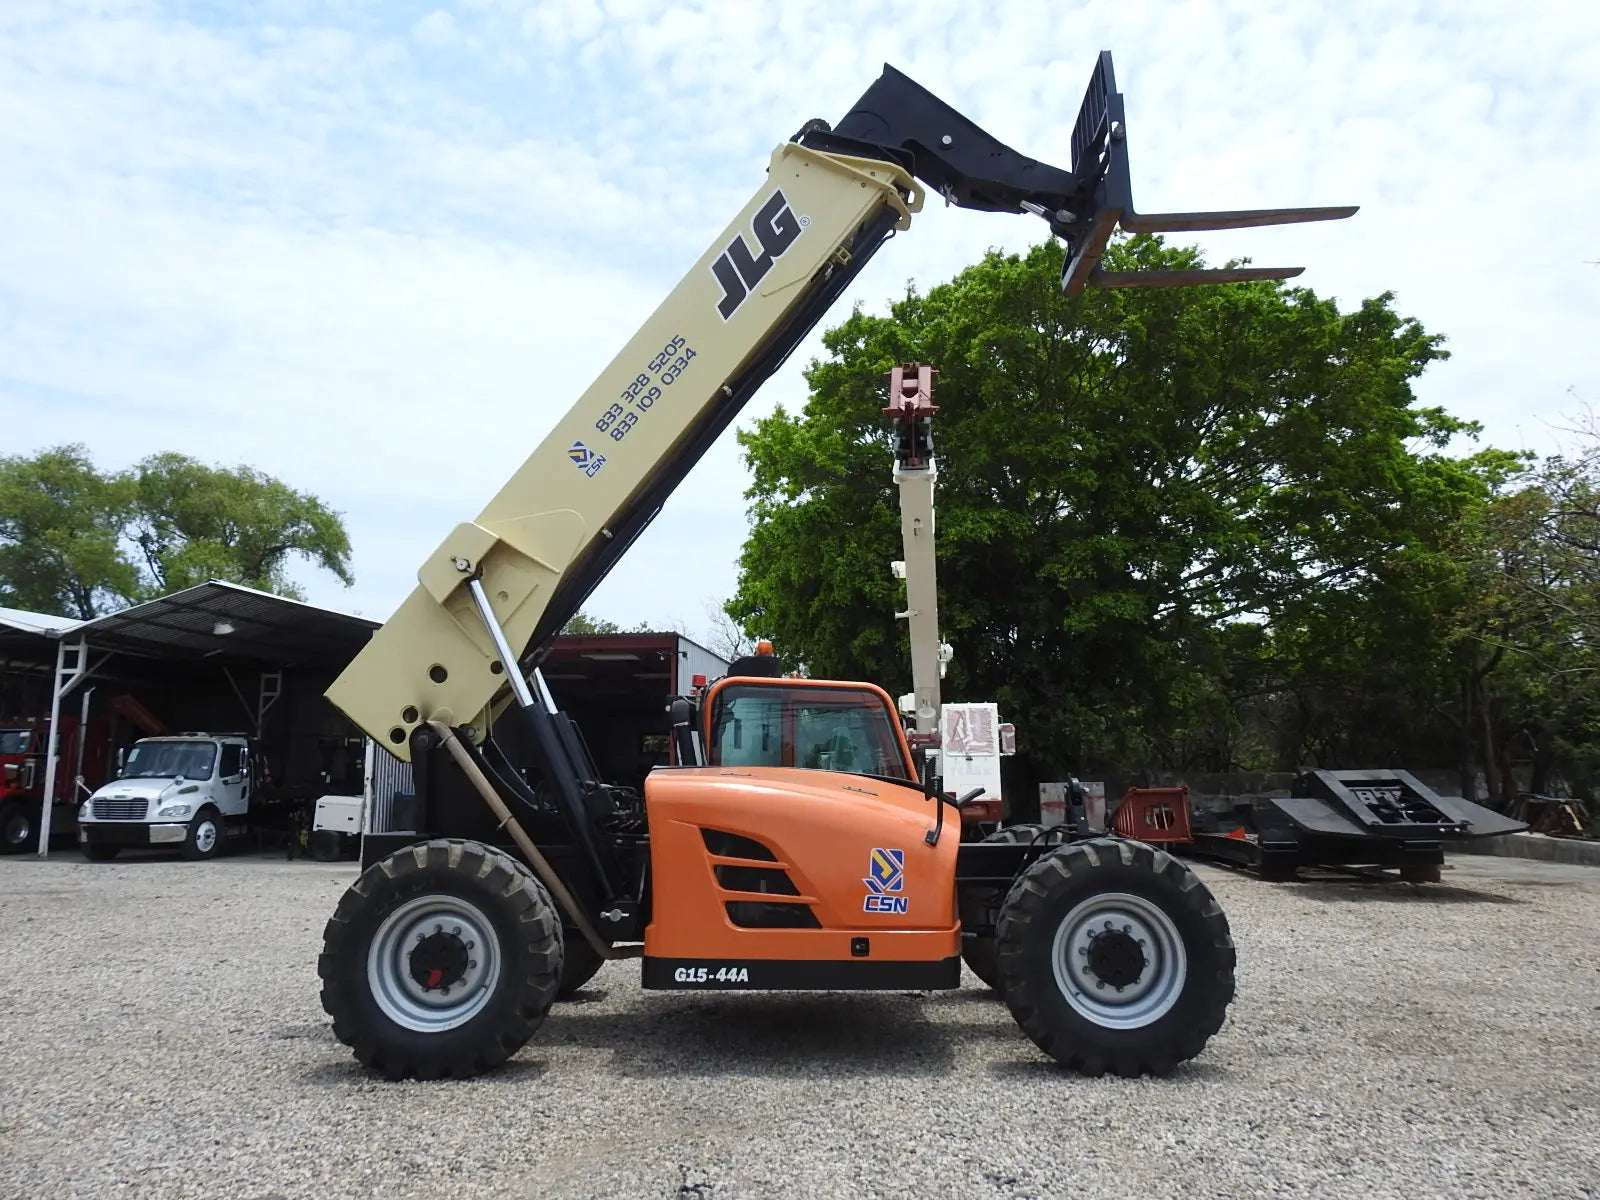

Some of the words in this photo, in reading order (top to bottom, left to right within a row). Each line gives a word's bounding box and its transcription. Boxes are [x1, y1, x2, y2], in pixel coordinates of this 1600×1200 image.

[710, 188, 802, 321] JLG
[596, 403, 624, 432] 833
[621, 373, 651, 404] 328
[648, 334, 686, 374] 5205
[610, 412, 639, 442] 833
[636, 387, 662, 412] 109
[661, 347, 697, 386] 0334
[586, 455, 607, 478] CSN
[864, 896, 908, 913] CSN
[675, 967, 749, 982] G15-44A
